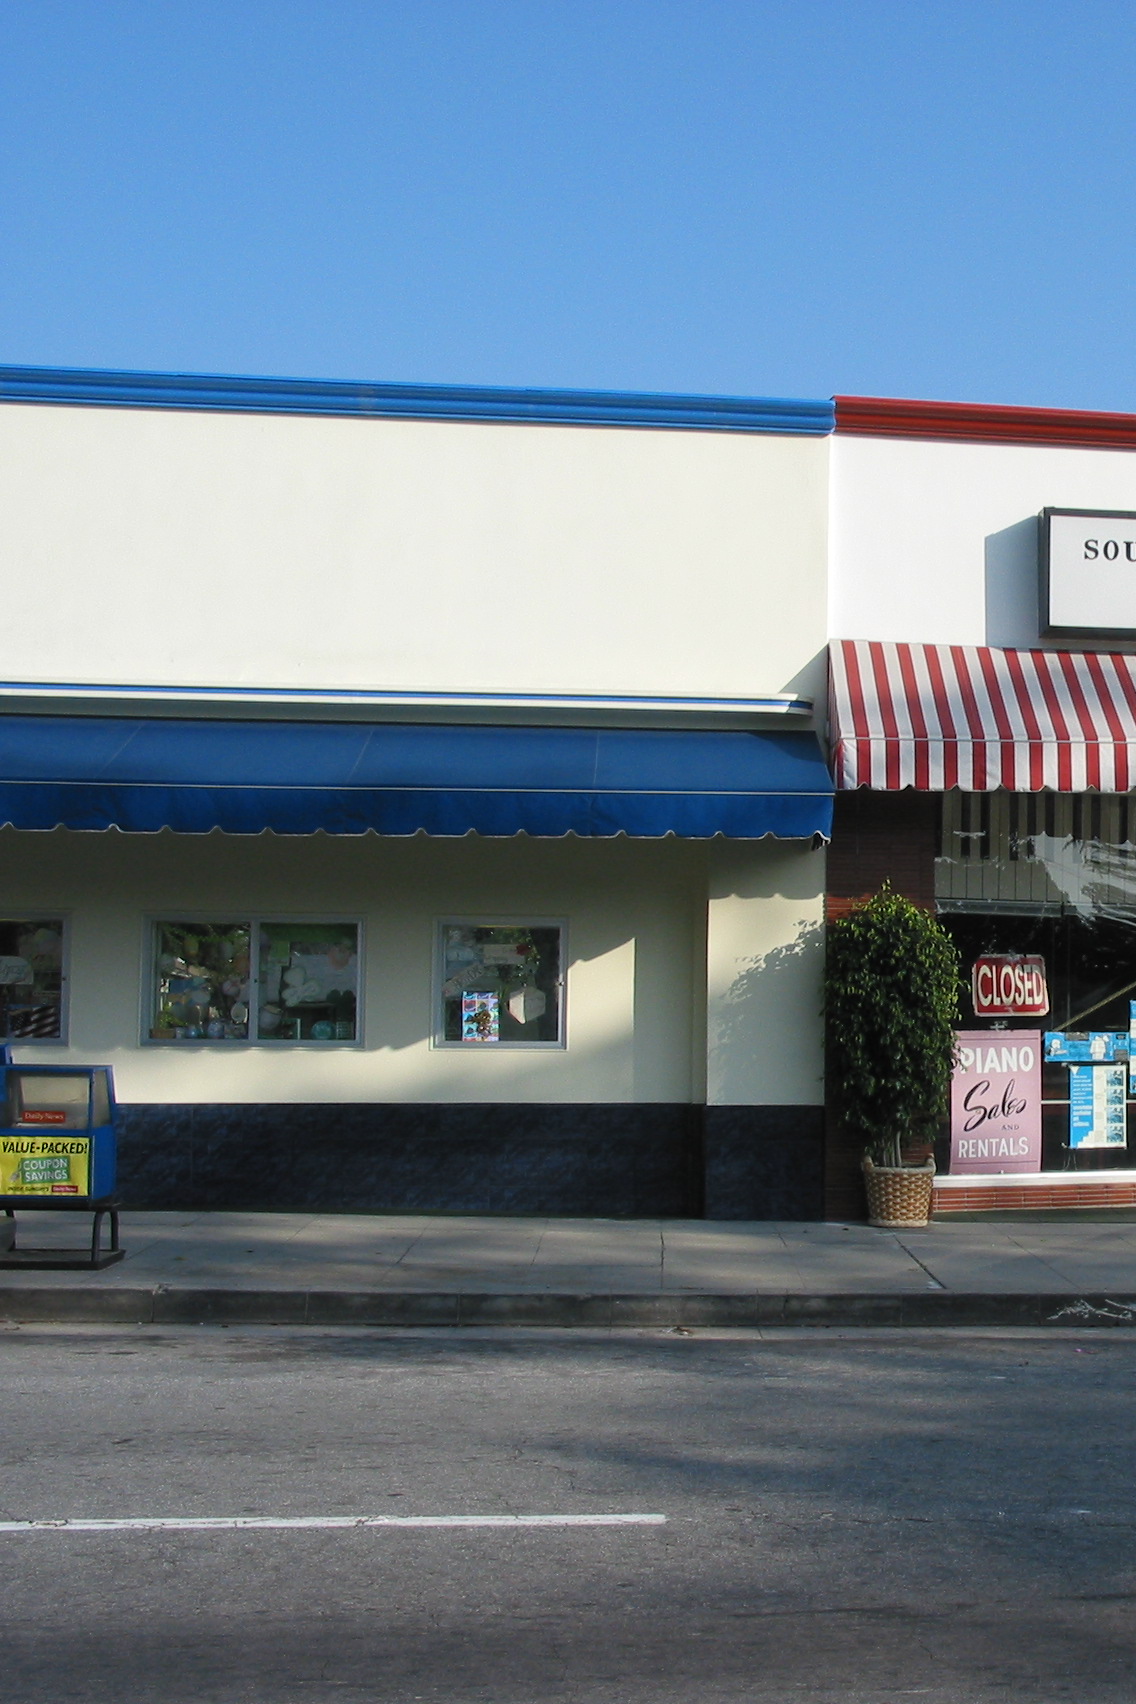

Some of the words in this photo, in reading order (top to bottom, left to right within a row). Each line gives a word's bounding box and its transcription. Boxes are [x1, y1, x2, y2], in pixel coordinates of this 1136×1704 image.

[977, 964, 1044, 1007] CLOSED
[960, 1046, 1035, 1074] PIANO
[963, 1078, 1028, 1132] Sales
[2, 1141, 88, 1154] VALUE-PACKED!
[958, 1137, 1029, 1158] RENTALS
[23, 1158, 68, 1171] COUPON
[25, 1169, 68, 1182] SAVINGS
